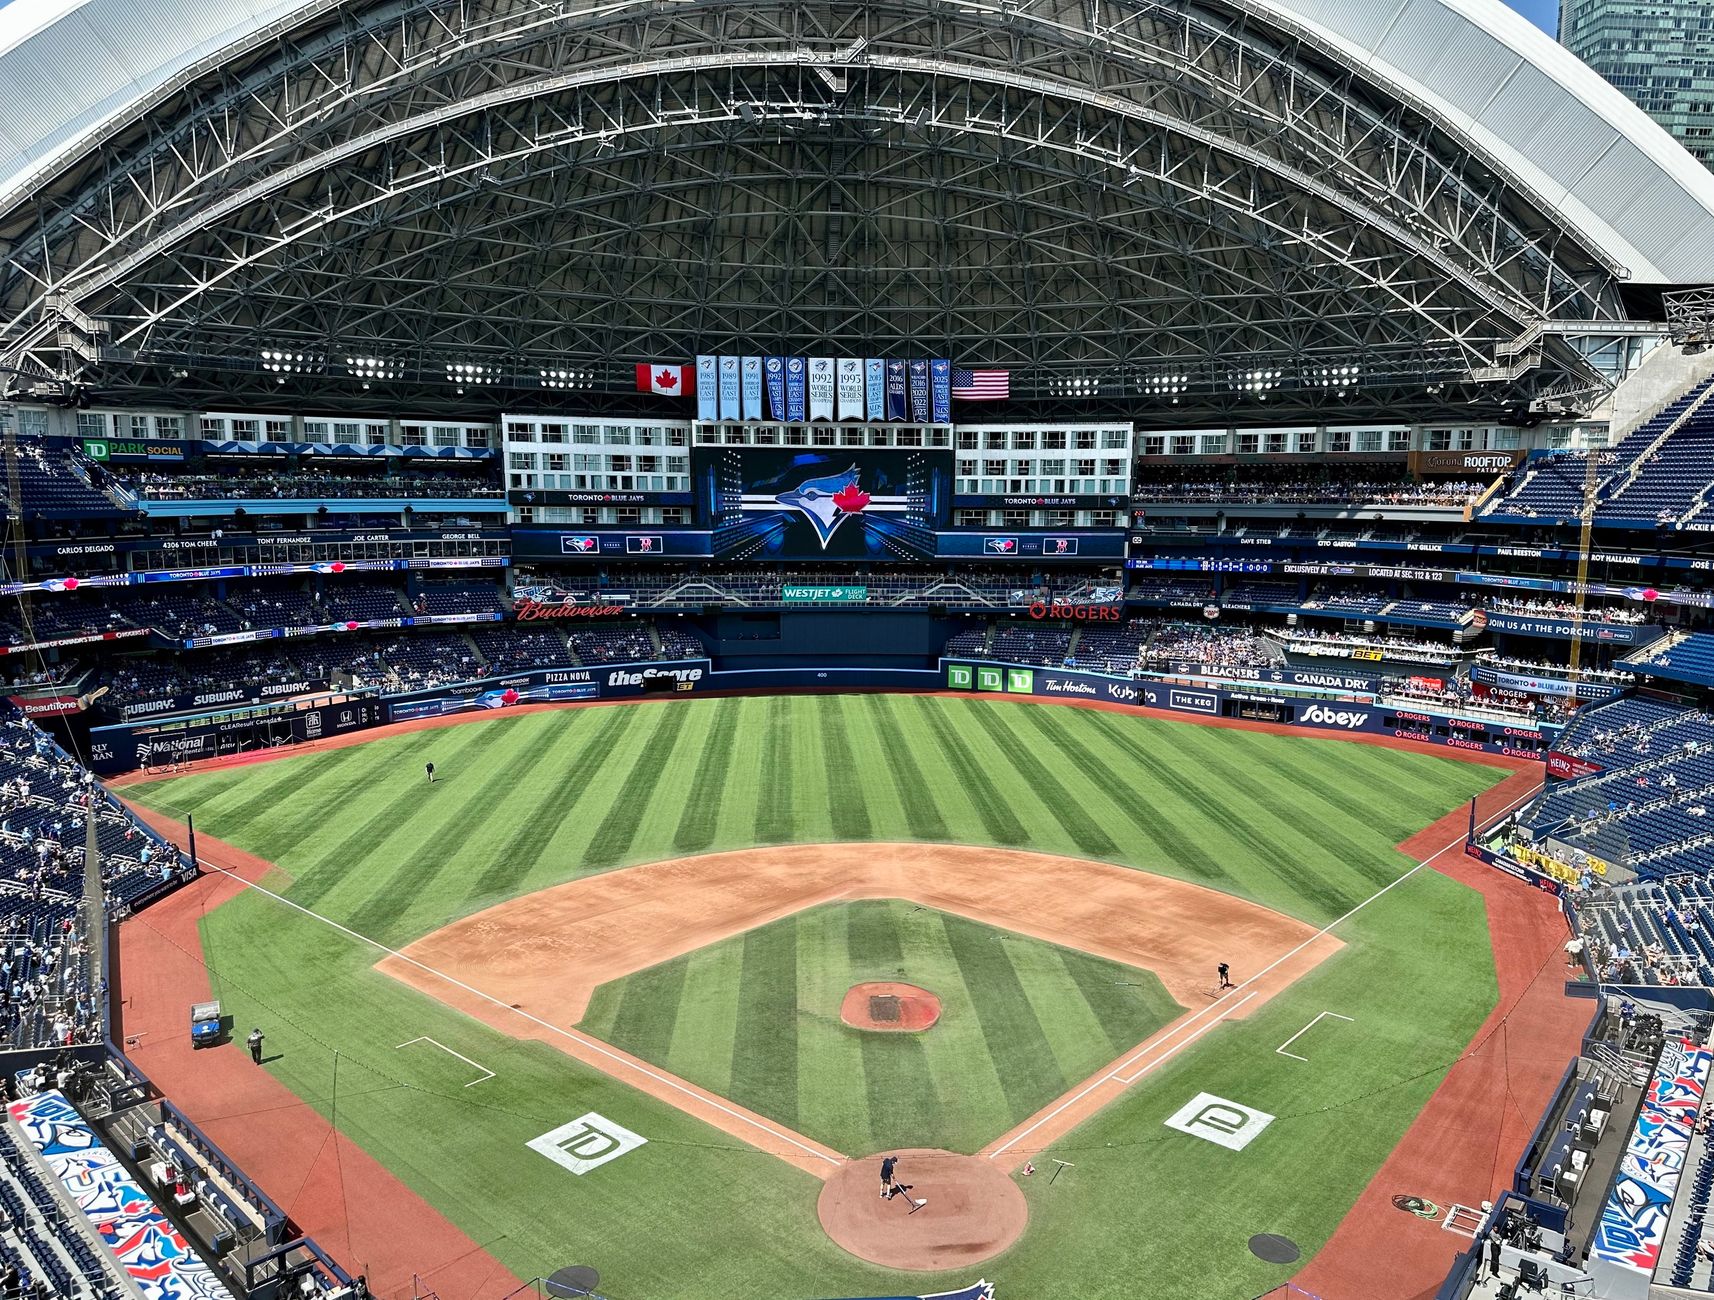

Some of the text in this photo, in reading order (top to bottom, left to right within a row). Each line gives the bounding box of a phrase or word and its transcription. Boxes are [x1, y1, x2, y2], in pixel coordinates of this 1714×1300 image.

[812, 374, 832, 384] 1992
[840, 374, 861, 383] 1993
[85, 442, 146, 456] TD PARK
[147, 446, 184, 455] SOCIAL
[1428, 456, 1512, 468] Corona ROOFTOP
[568, 494, 644, 502] TORONTO BLUE JAYS
[85, 545, 114, 553] DELGADO
[1606, 555, 1640, 564] HALLADAY
[1691, 561, 1709, 569] JOSÉ
[1284, 565, 1319, 574] EXCLUSIVELY
[1369, 568, 1393, 577] LOCATED
[1401, 570, 1413, 578] SEC.
[1415, 571, 1424, 579] 112
[1432, 572, 1442, 580] 123
[784, 588, 831, 600] WESTJET
[512, 600, 625, 620] Budweiser
[1050, 605, 1120, 620] ROGERS
[1489, 619, 1505, 628] JOIN
[1507, 622, 1518, 630] US
[1535, 625, 1552, 633] THE
[1555, 626, 1594, 637] PORCH!
[8, 645, 29, 653] PROUD
[29, 642, 49, 650] OWNER
[1288, 643, 1383, 661] theScore BET
[546, 672, 590, 682] PIZZA NOVA
[951, 670, 970, 684] TD
[1201, 665, 1260, 679] BLEACHERS
[981, 672, 999, 686] TD
[1011, 673, 1030, 688] TD
[1295, 673, 1343, 687] CANADA
[1498, 676, 1573, 693] TORONTO BLUE JAYS
[261, 682, 310, 696] SUBWAY
[1045, 679, 1096, 694] Tim Hortons
[193, 689, 244, 705] SUBWAY
[1499, 689, 1527, 699] ROGERS
[25, 701, 77, 713] BeautiTone
[125, 699, 175, 715] SUBWAY
[1176, 696, 1211, 707] THE KEG
[1300, 705, 1368, 728] Sobeys
[1403, 711, 1431, 722] ROGERS
[220, 720, 254, 731] CLEAResult
[1457, 721, 1485, 731] ROGERS
[1403, 732, 1429, 741] ROGERS
[1513, 729, 1542, 739] ROGERS
[152, 736, 204, 753] National
[1455, 740, 1483, 750] ROGERS
[1511, 750, 1541, 760] ROGERS
[1550, 759, 1571, 772] HEINZ
[1467, 846, 1482, 858] HEINZ
[1585, 856, 1607, 875] 328
[1539, 879, 1557, 892] HEINZ
[1184, 1103, 1250, 1135] TD
[556, 1121, 622, 1161] TD
